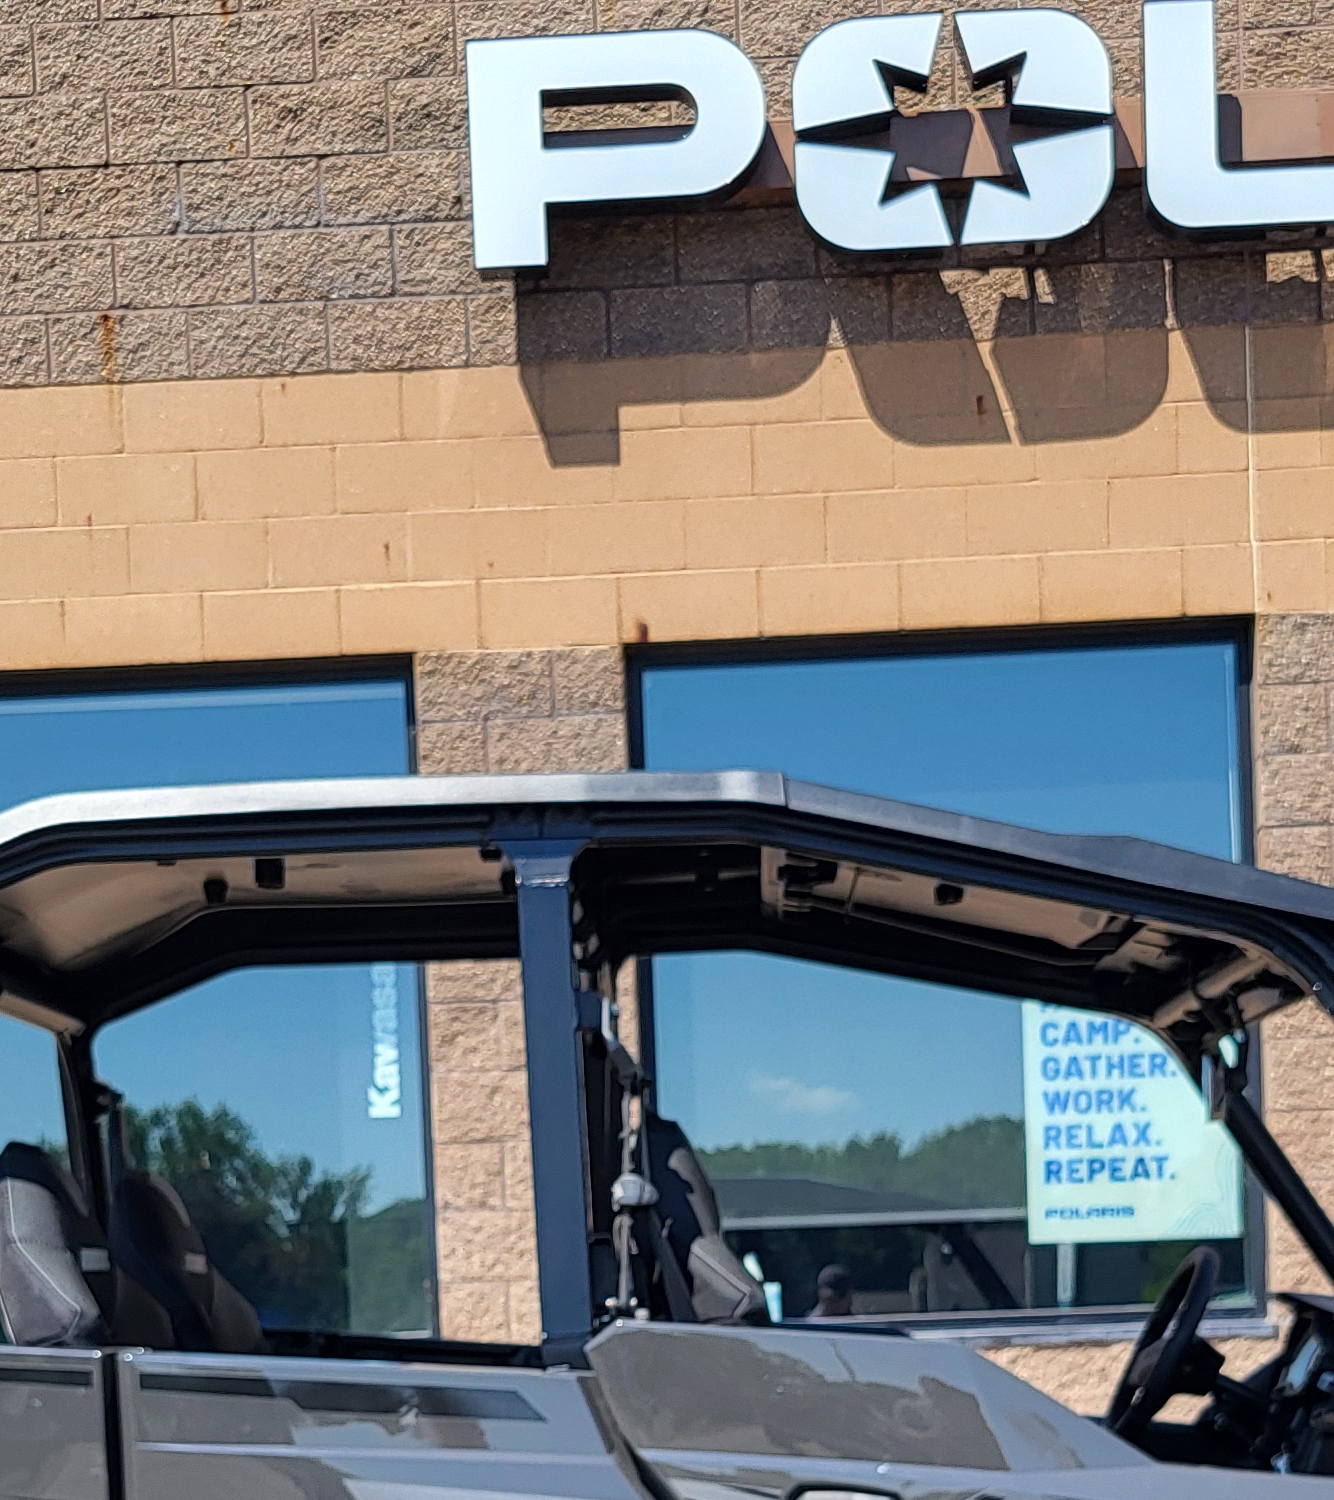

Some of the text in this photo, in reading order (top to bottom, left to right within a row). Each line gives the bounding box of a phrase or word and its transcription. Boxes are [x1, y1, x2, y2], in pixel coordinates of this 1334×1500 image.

[1039, 1018, 1140, 1048] CAMP.
[1040, 1052, 1178, 1083] GATHER.
[1041, 1087, 1147, 1116] WORK.
[1042, 1121, 1163, 1150] RELAX.
[1043, 1154, 1178, 1184] REPEAT.
